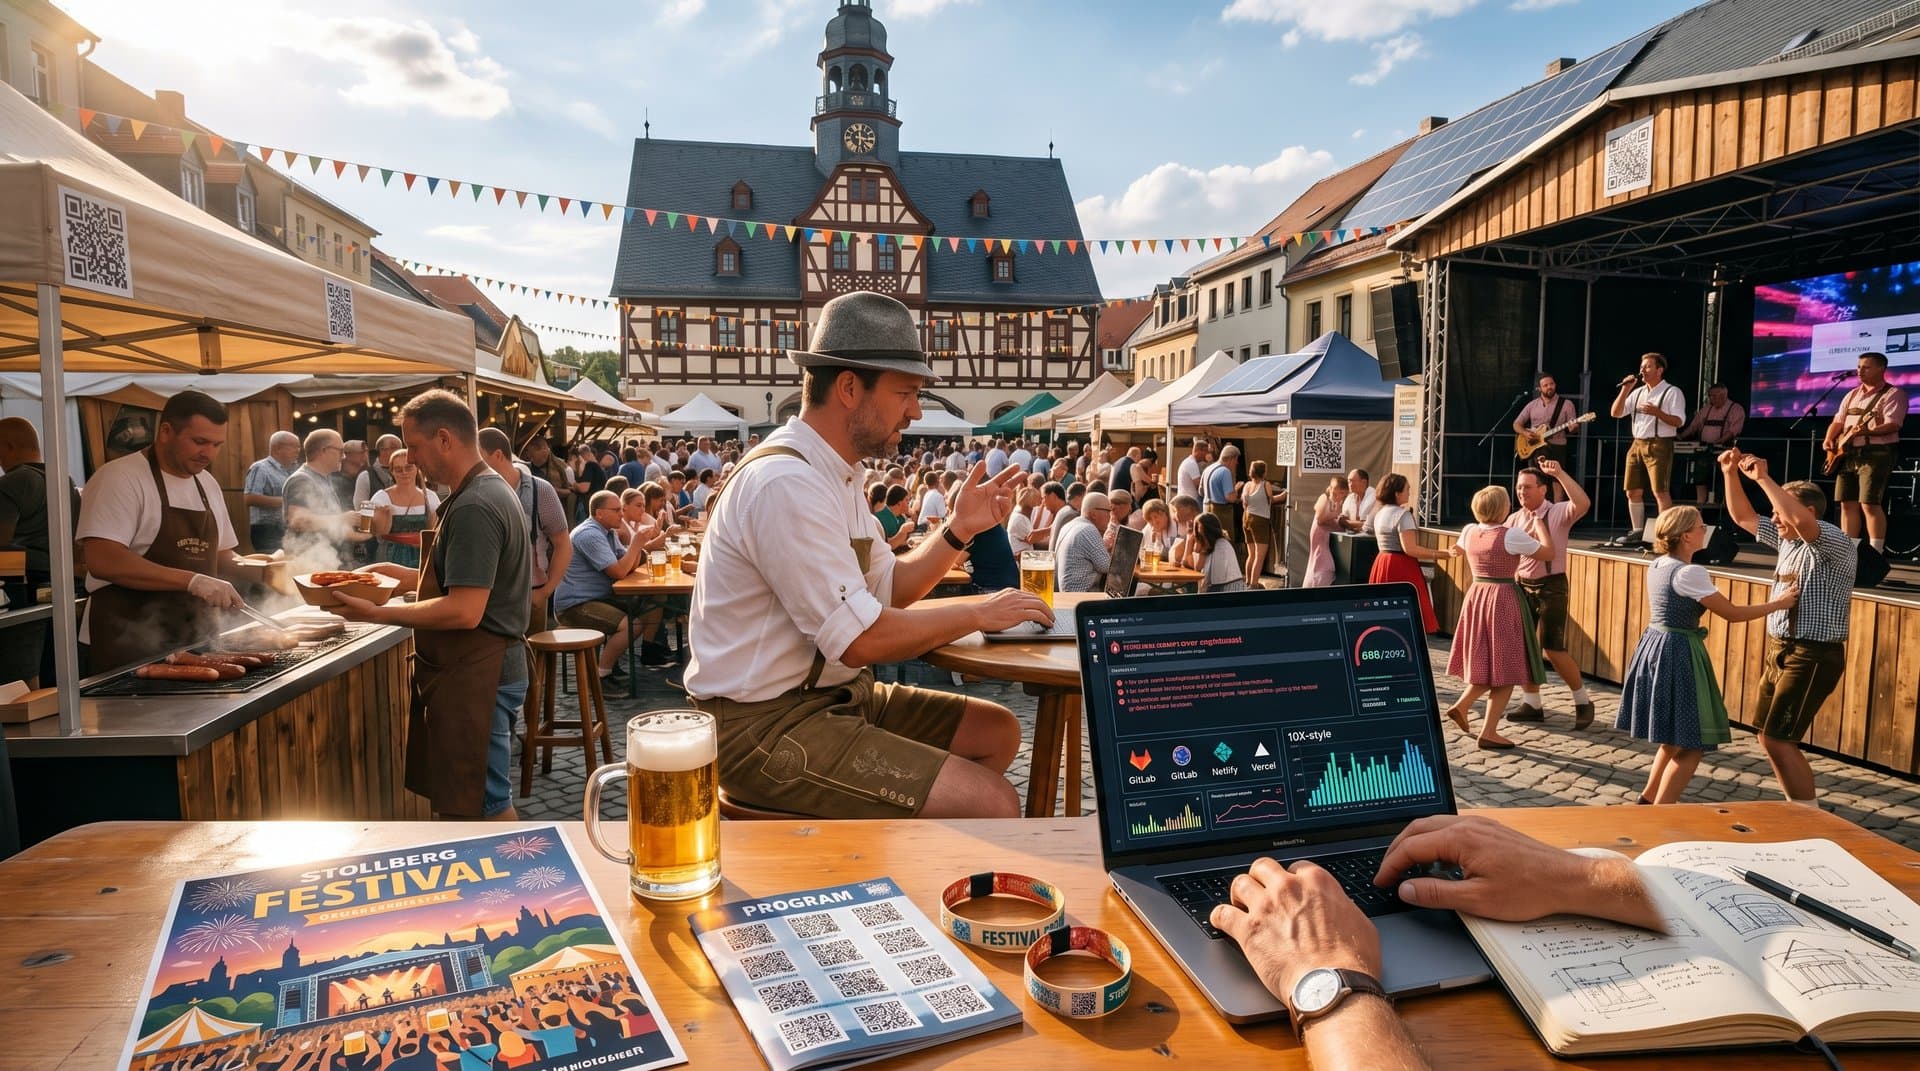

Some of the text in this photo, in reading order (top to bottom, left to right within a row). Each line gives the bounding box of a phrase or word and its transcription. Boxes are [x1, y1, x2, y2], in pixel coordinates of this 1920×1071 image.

[1361, 649, 1406, 661] 688/2092
[1287, 729, 1332, 742] 10X-style
[1211, 765, 1239, 777] Netlify
[1251, 761, 1277, 772] Vercel
[1128, 774, 1157, 785] GitLab
[1170, 770, 1198, 781] GitLab
[300, 849, 457, 883] STOLLBERG
[253, 857, 511, 919] FESTIVAL
[742, 890, 854, 917] PROGRAM
